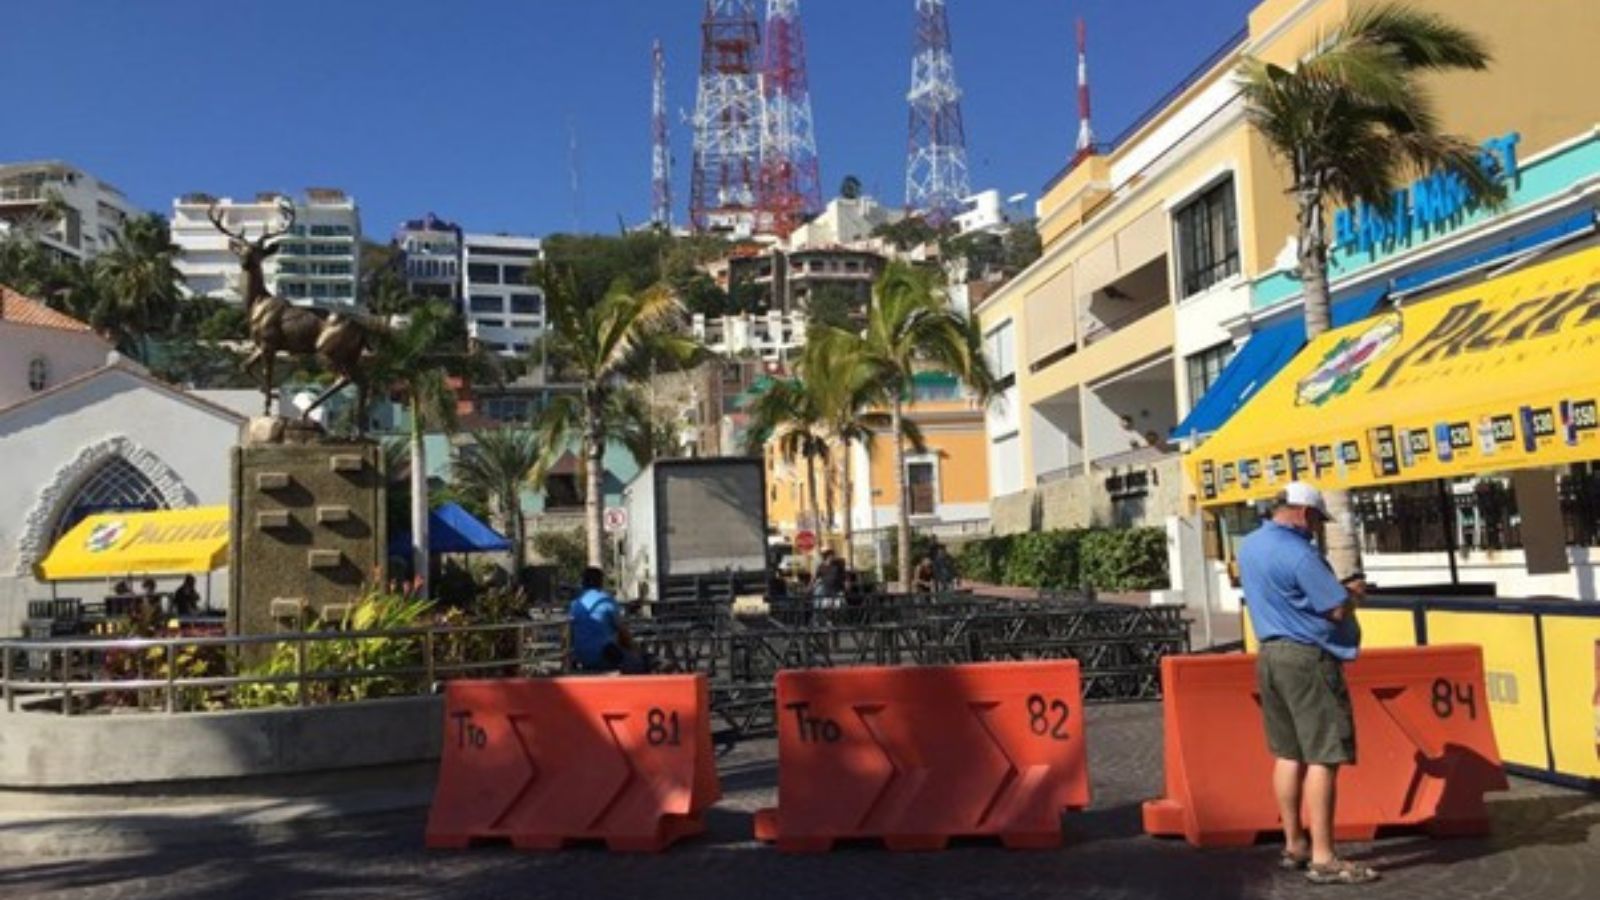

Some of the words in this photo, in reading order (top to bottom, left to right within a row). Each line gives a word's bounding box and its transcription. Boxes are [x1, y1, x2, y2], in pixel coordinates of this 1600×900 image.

[1027, 694, 1069, 740] 82
[1431, 677, 1476, 720] 84
[645, 709, 680, 746] 81
